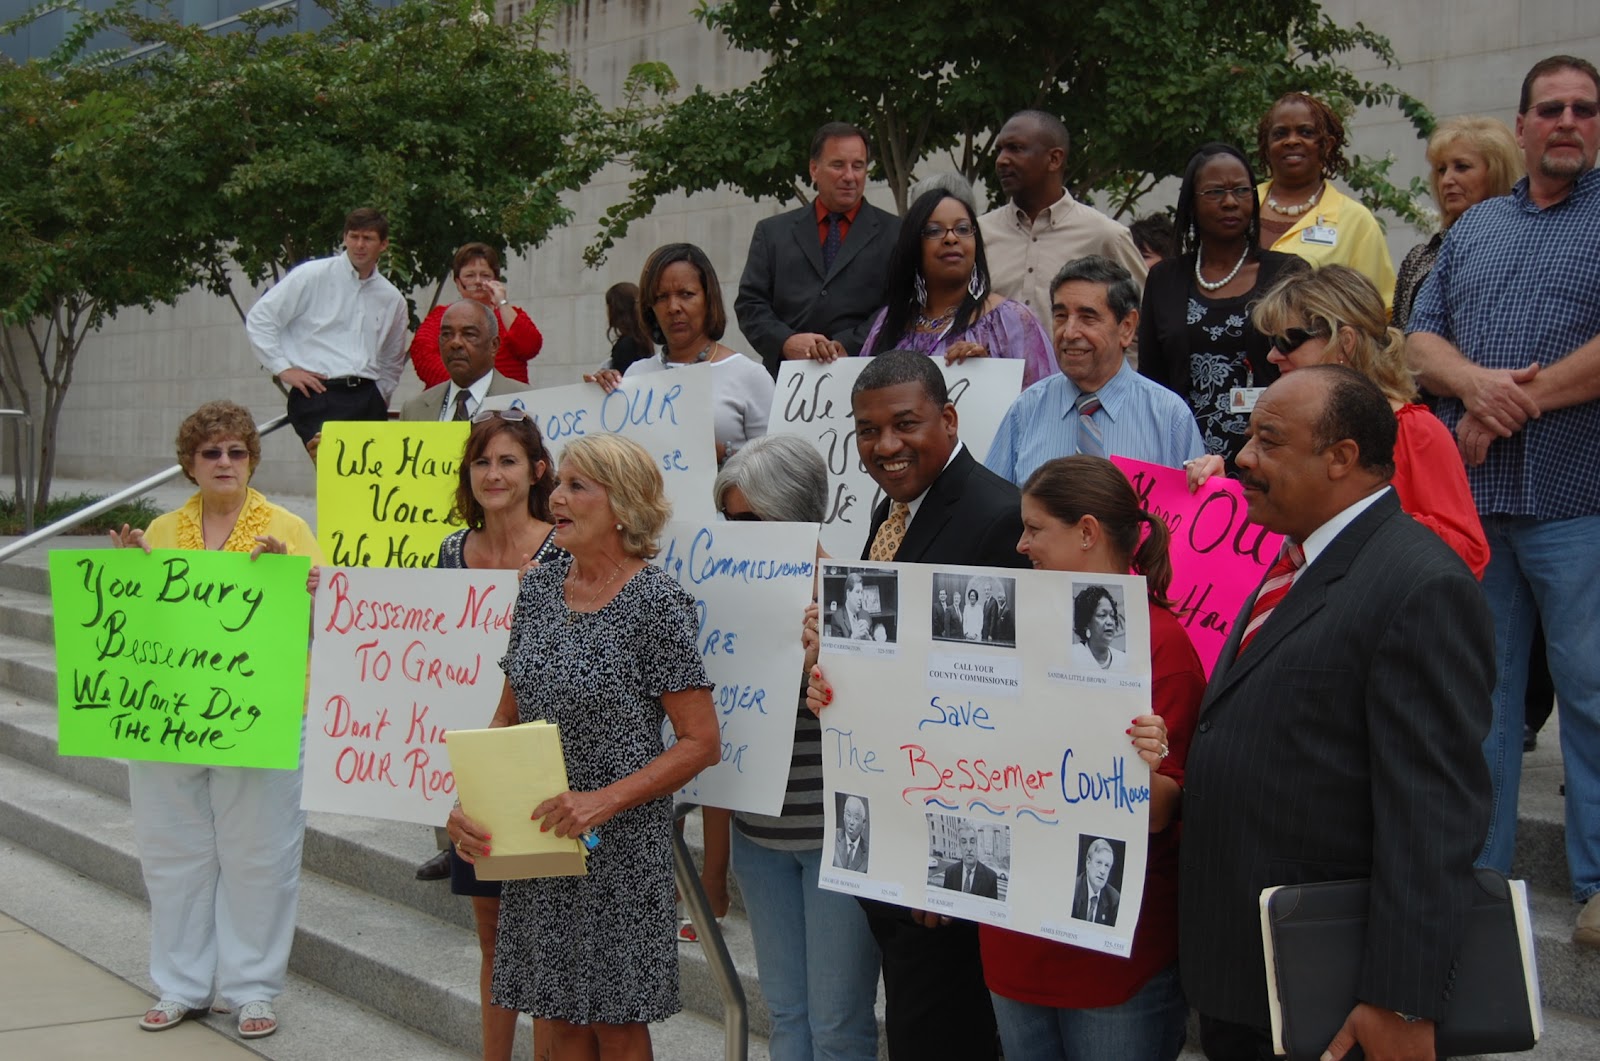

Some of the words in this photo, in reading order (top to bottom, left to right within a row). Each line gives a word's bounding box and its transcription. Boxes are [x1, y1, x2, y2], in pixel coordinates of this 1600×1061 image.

[601, 385, 682, 433] OUR
[784, 371, 834, 423] We
[335, 438, 383, 478] We
[395, 436, 460, 480] Hav
[331, 529, 371, 568] We
[384, 534, 439, 568] Hav
[77, 558, 145, 628] You
[156, 557, 265, 632] Bury
[355, 639, 392, 682] TO
[401, 640, 481, 689] GROW
[929, 669, 958, 680] COUNTY
[959, 673, 1019, 687] COMMISSIONERS
[953, 662, 973, 672] CALL
[974, 664, 994, 674] YOUR
[1047, 671, 1068, 680] SANDRA
[1068, 674, 1086, 682] LITTLE
[1086, 676, 1107, 684] BROWN
[74, 668, 111, 704] We
[119, 676, 189, 716] Won't
[199, 686, 263, 732] Dig
[918, 696, 995, 731] Save
[160, 717, 237, 751] Hole
[335, 746, 398, 788] OUR
[403, 747, 456, 801] ROO
[825, 728, 885, 774] The
[900, 744, 1053, 806] Bessemer
[1060, 748, 1150, 814] Courthouse
